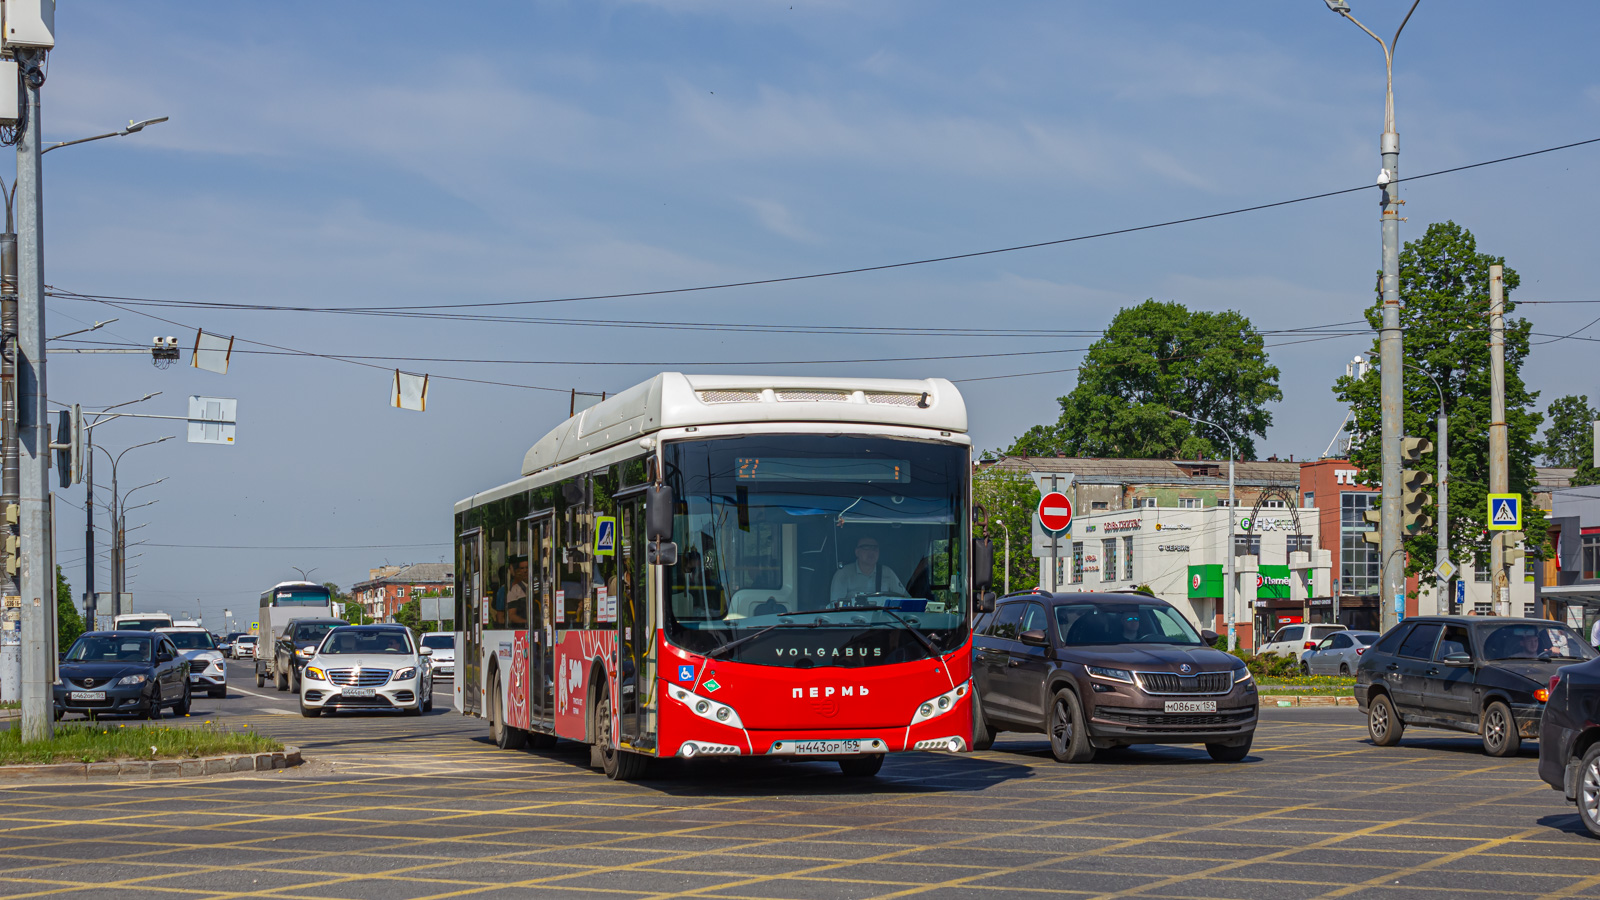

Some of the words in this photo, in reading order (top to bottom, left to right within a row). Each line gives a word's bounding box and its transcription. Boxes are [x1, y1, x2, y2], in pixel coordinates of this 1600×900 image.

[1254, 517, 1277, 531] FIX
[776, 648, 882, 657] VOLGABUS
[792, 685, 869, 698] ПЕРМЬ
[1167, 702, 1201, 711] М086ЕХ
[1202, 701, 1215, 709] 159
[798, 741, 840, 753] Н443ОР
[842, 740, 858, 749] 159
